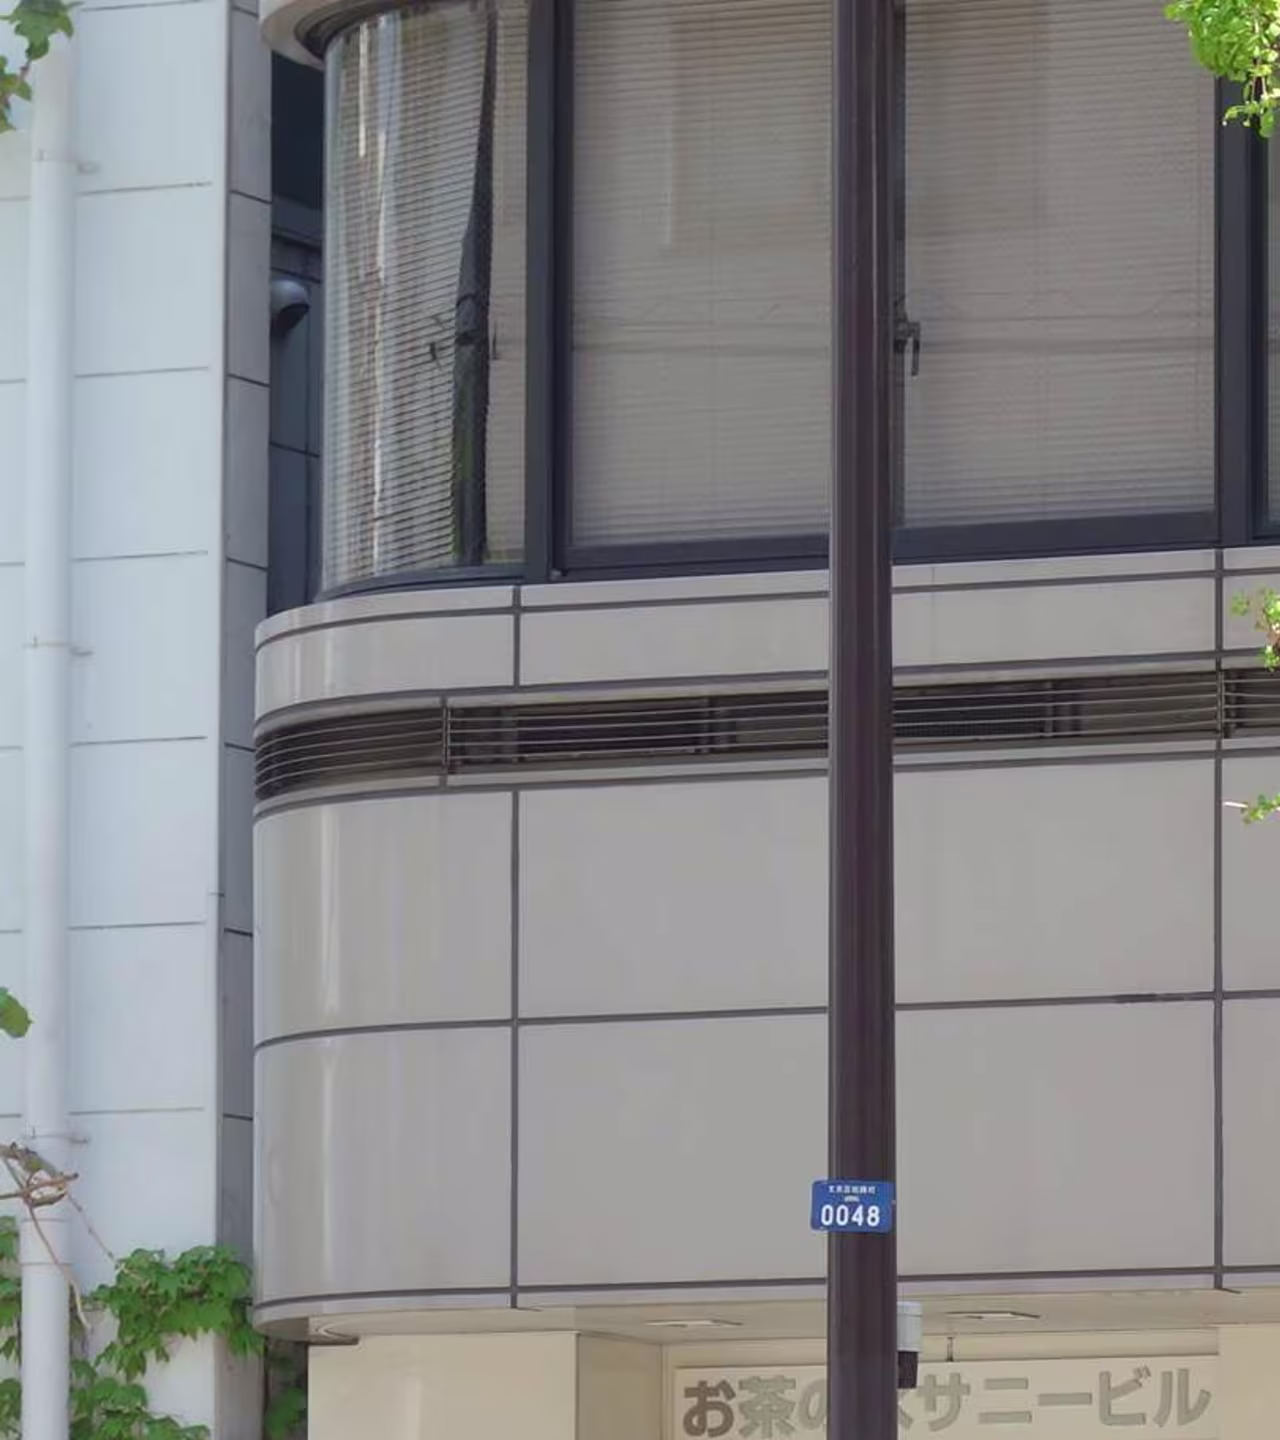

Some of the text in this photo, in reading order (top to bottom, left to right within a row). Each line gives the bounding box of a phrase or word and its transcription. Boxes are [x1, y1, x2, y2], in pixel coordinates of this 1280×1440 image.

[820, 1205, 880, 1226] 0048
[682, 1365, 1211, 1439] お茶サニービル
